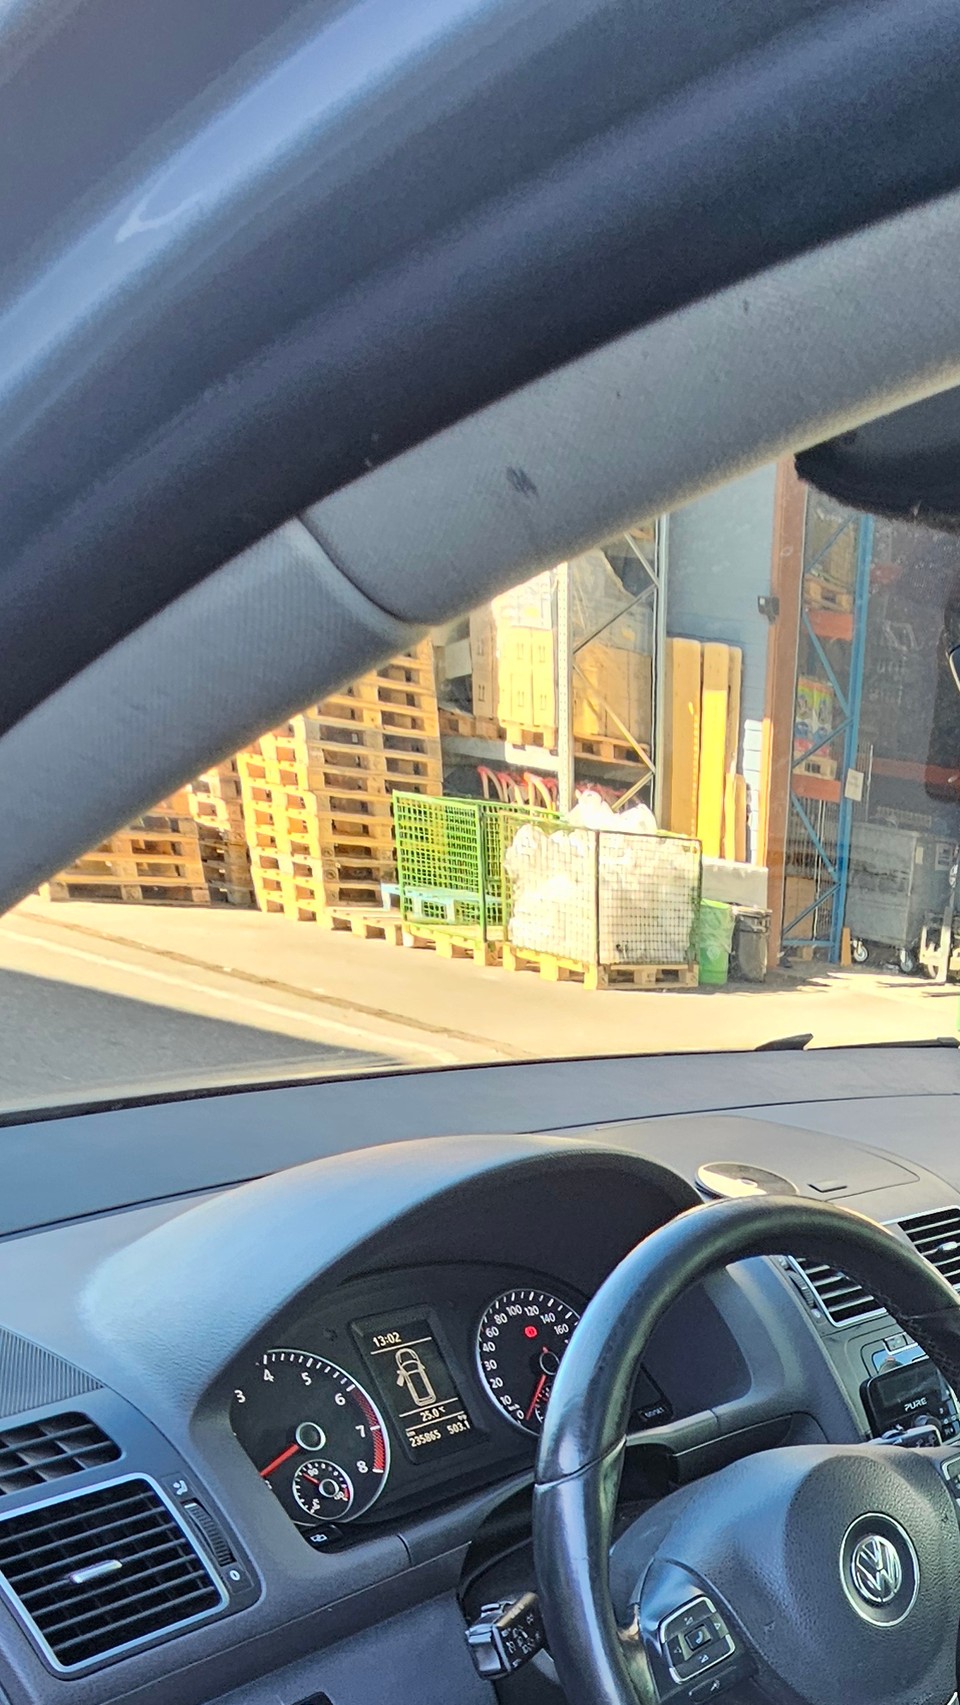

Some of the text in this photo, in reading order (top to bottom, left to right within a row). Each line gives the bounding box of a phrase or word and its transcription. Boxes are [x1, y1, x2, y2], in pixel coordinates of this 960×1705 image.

[506, 1304, 522, 1317] 100
[524, 1306, 540, 1317] 120
[494, 1313, 508, 1325] 80
[540, 1312, 556, 1325] 140
[485, 1326, 499, 1338] 60
[553, 1323, 569, 1335] 160
[372, 1331, 402, 1348] 13:02
[482, 1341, 496, 1353] 40
[484, 1359, 498, 1371] 30
[263, 1368, 275, 1383] 4
[301, 1371, 312, 1386] 5
[490, 1377, 504, 1389] 20
[234, 1389, 246, 1404] 3
[334, 1392, 346, 1406] 6
[500, 1394, 512, 1406] 10
[904, 1397, 928, 1412] PURE
[420, 1408, 439, 1421] 25.0
[516, 1410, 525, 1420] 0
[355, 1424, 366, 1438] 7
[409, 1420, 471, 1448] 235865 503.1
[356, 1460, 368, 1473] 8
[852, 1535, 902, 1602] VW
